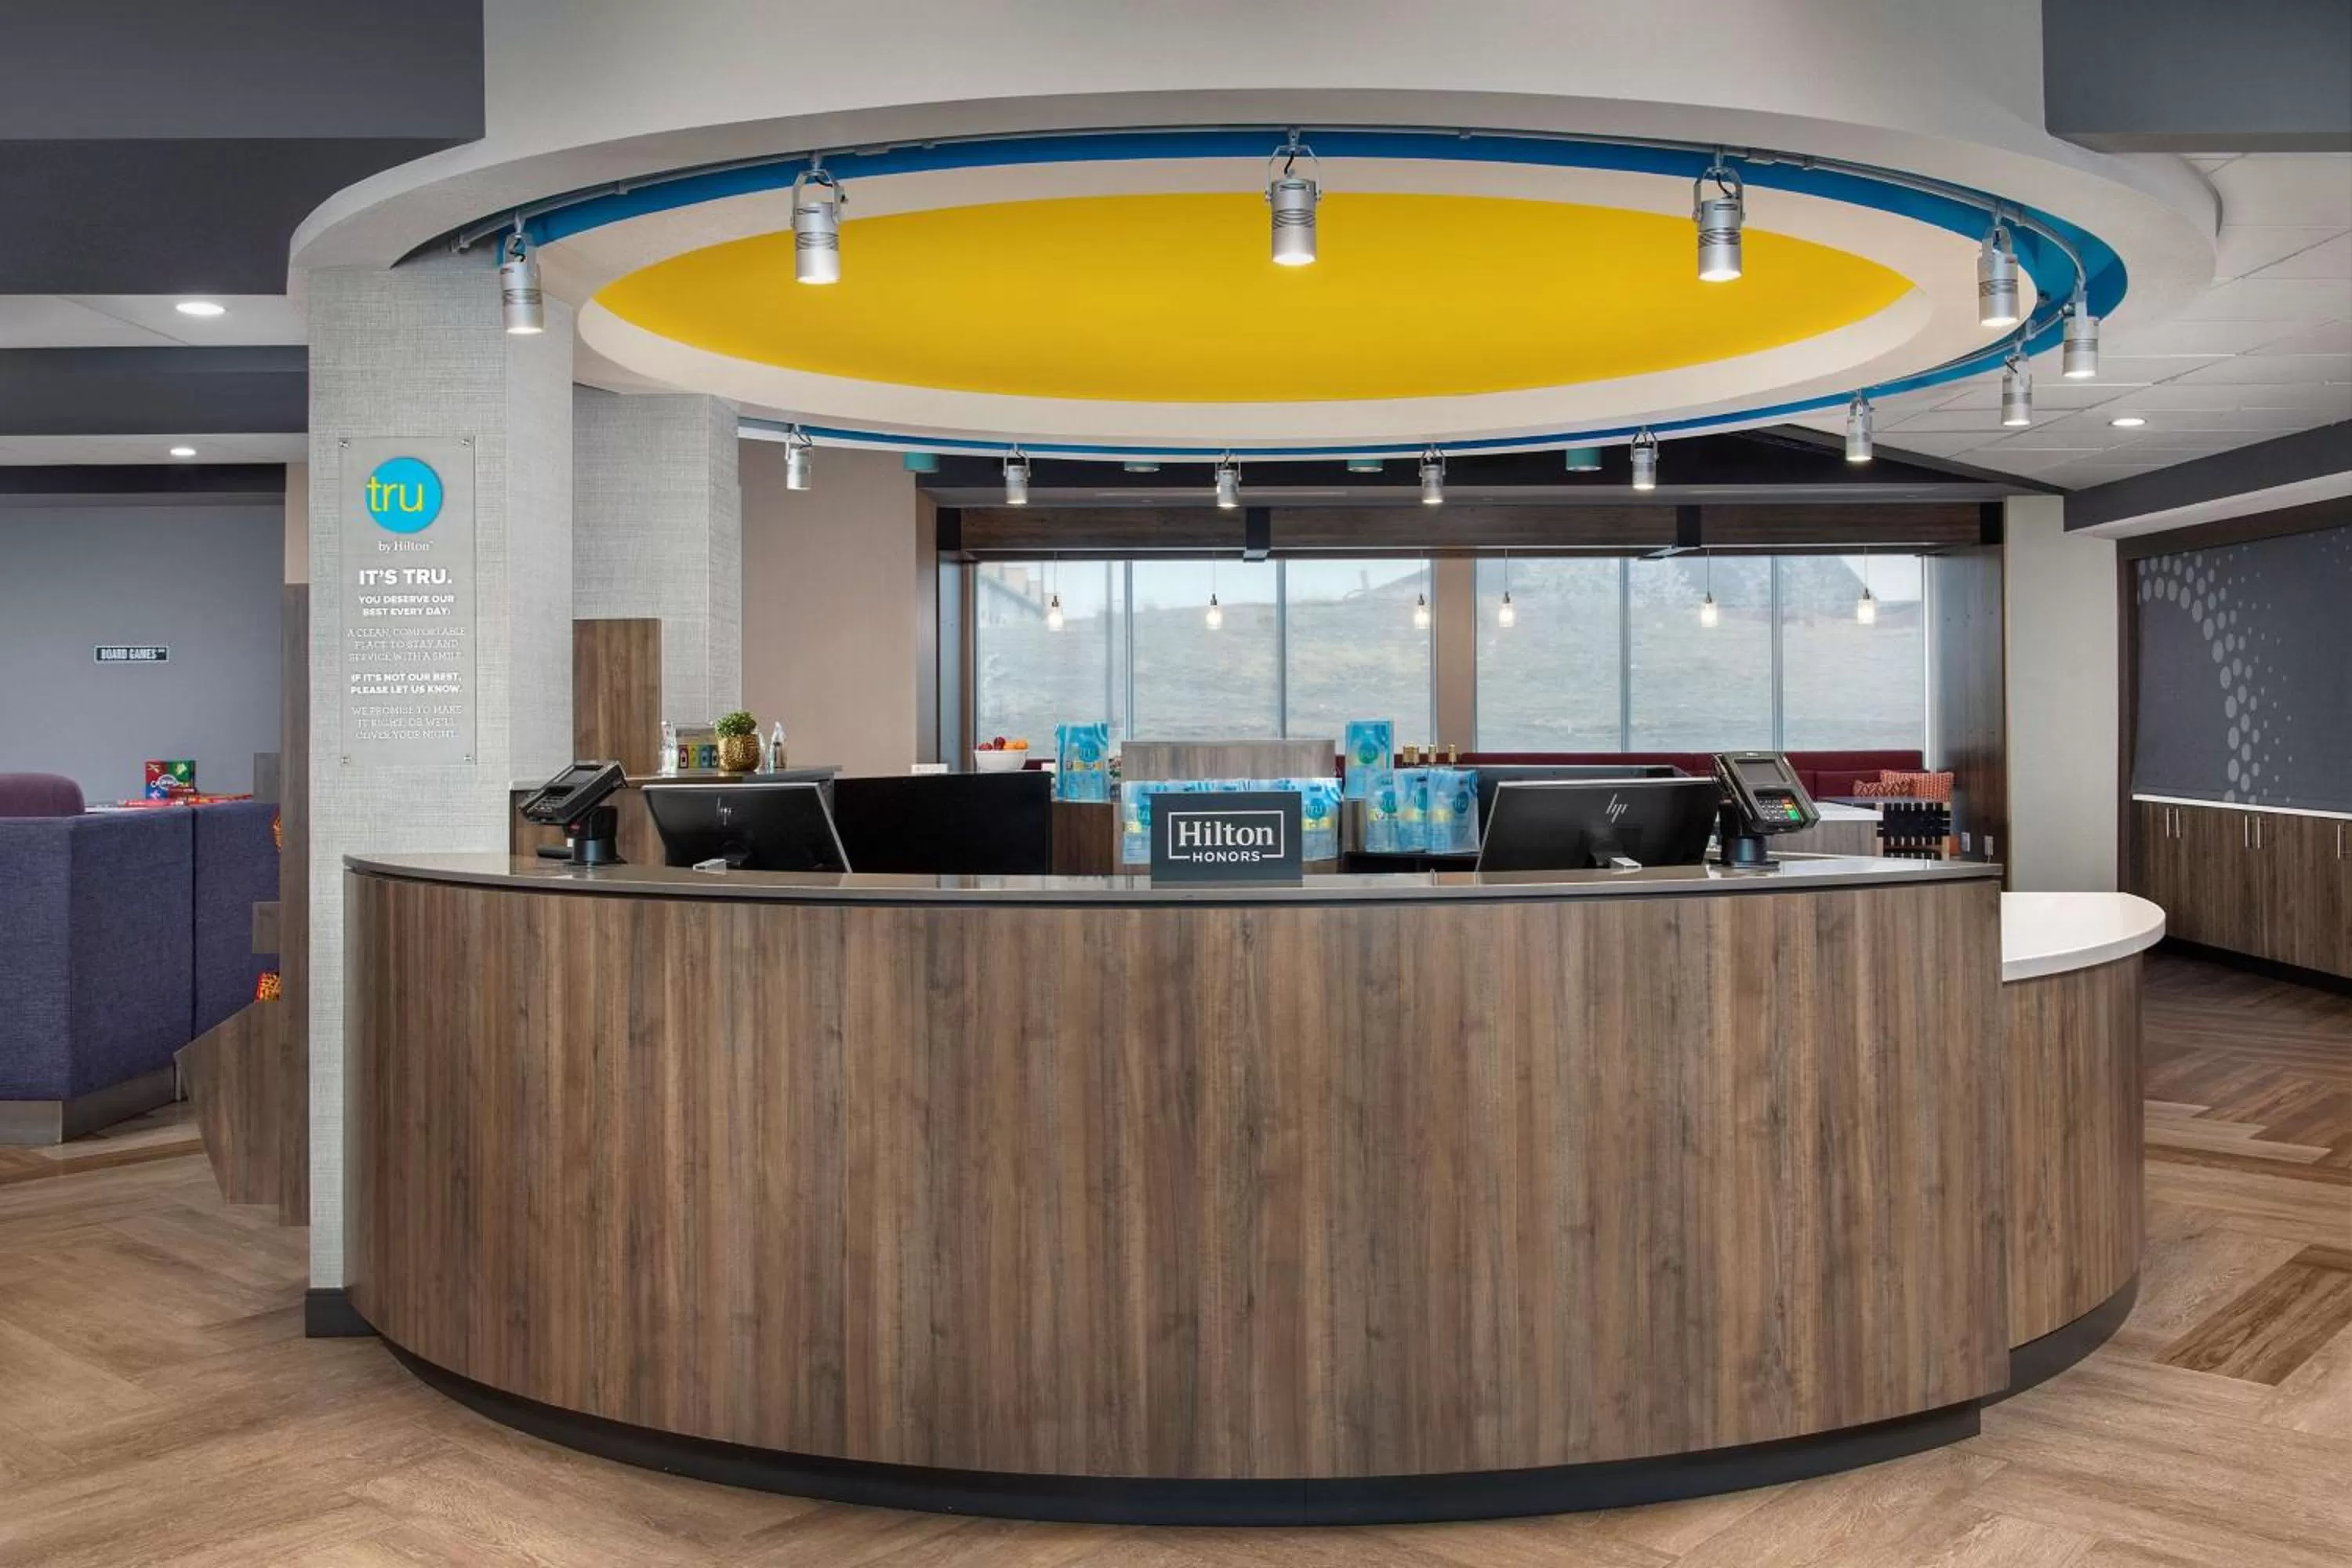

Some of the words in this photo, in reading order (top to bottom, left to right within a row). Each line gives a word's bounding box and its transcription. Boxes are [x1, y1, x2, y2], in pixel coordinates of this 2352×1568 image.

[367, 476, 424, 512] tru
[379, 540, 390, 554] by
[394, 540, 430, 551] Hilton
[359, 569, 397, 585] IT'S
[403, 568, 452, 584] TRU.
[359, 595, 380, 604] YOU
[101, 648, 128, 659] BOARD
[129, 648, 157, 659] GAMES
[351, 673, 361, 682] IF
[408, 673, 430, 681] OUR
[391, 685, 408, 694] LET
[411, 685, 426, 694] US
[1178, 822, 1275, 847] Hilton
[1192, 851, 1260, 862] HONORS
